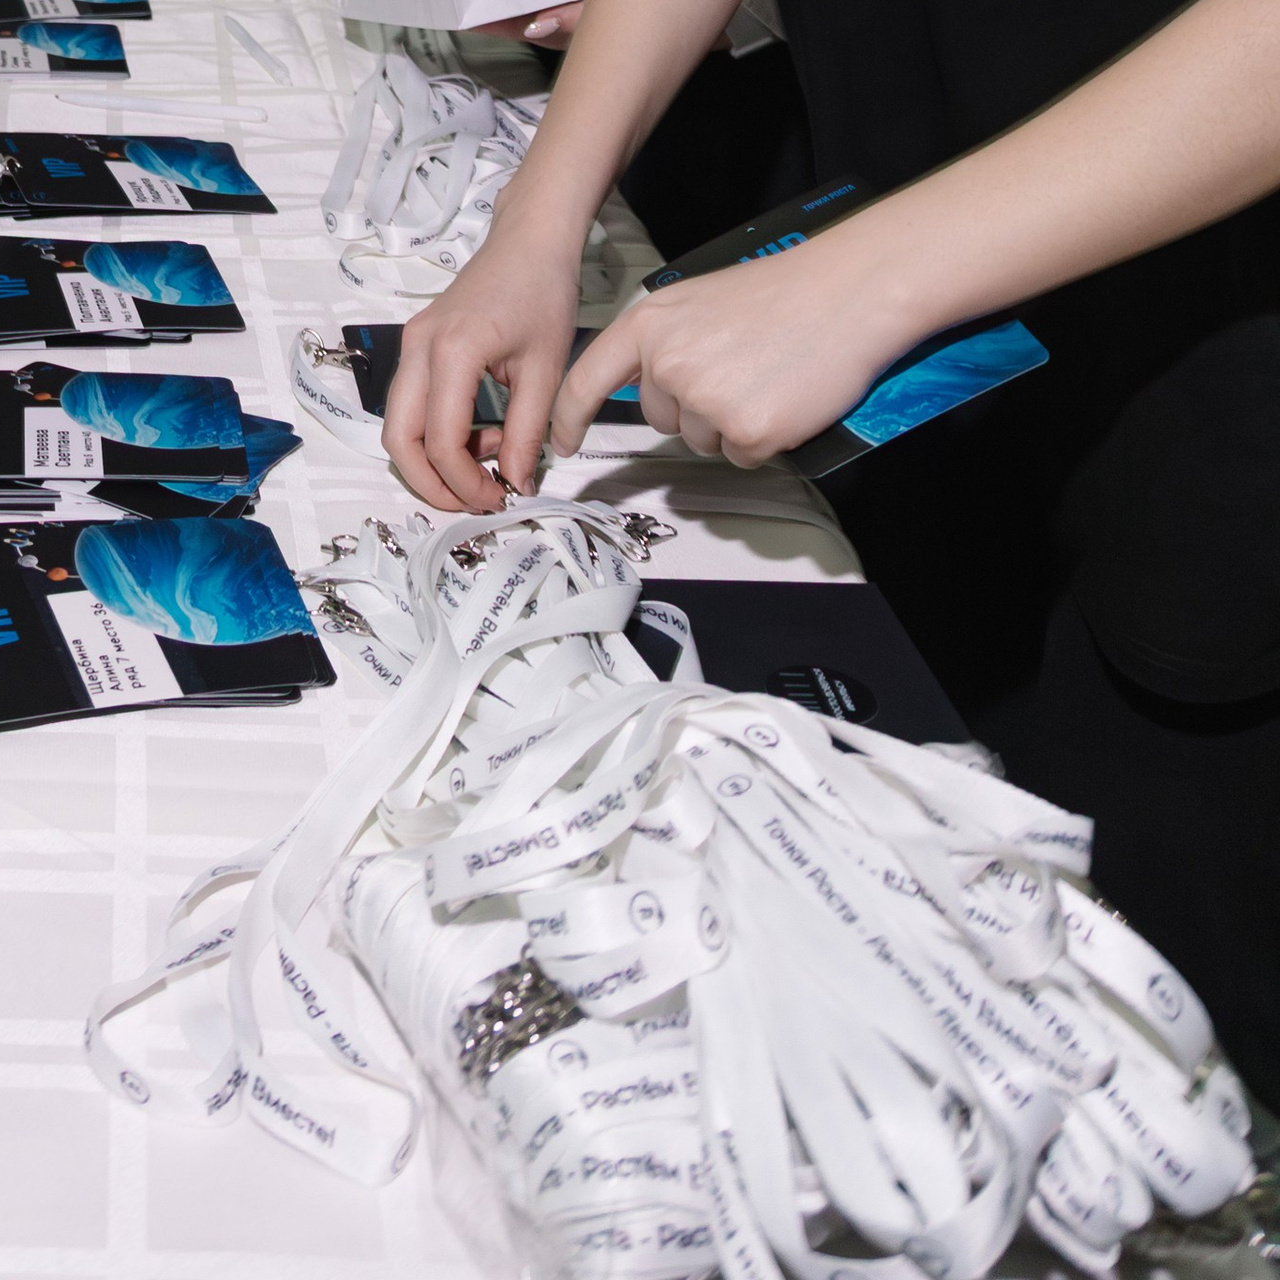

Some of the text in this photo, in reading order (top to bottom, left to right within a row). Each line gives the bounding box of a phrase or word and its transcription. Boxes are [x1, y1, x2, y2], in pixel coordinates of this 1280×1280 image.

[41, 158, 86, 178] VIP
[801, 184, 856, 212] ТОЧКИ РОСТА
[70, 281, 95, 324] Полтавченко
[91, 288, 114, 323] Анастасия
[296, 370, 317, 401] Точки
[34, 429, 50, 468] Матвеева
[55, 430, 71, 467] Светлана
[90, 601, 108, 616] 36
[489, 572, 526, 617] Растём
[102, 618, 128, 652] место
[465, 617, 498, 656] Вмес
[72, 638, 104, 695] Щербина
[99, 654, 123, 692] Алина
[124, 665, 146, 689] ряд
[359, 645, 392, 682] Точки
[487, 743, 522, 773] Точки
[463, 826, 560, 878] Вместе!
[763, 817, 810, 869] Точки
